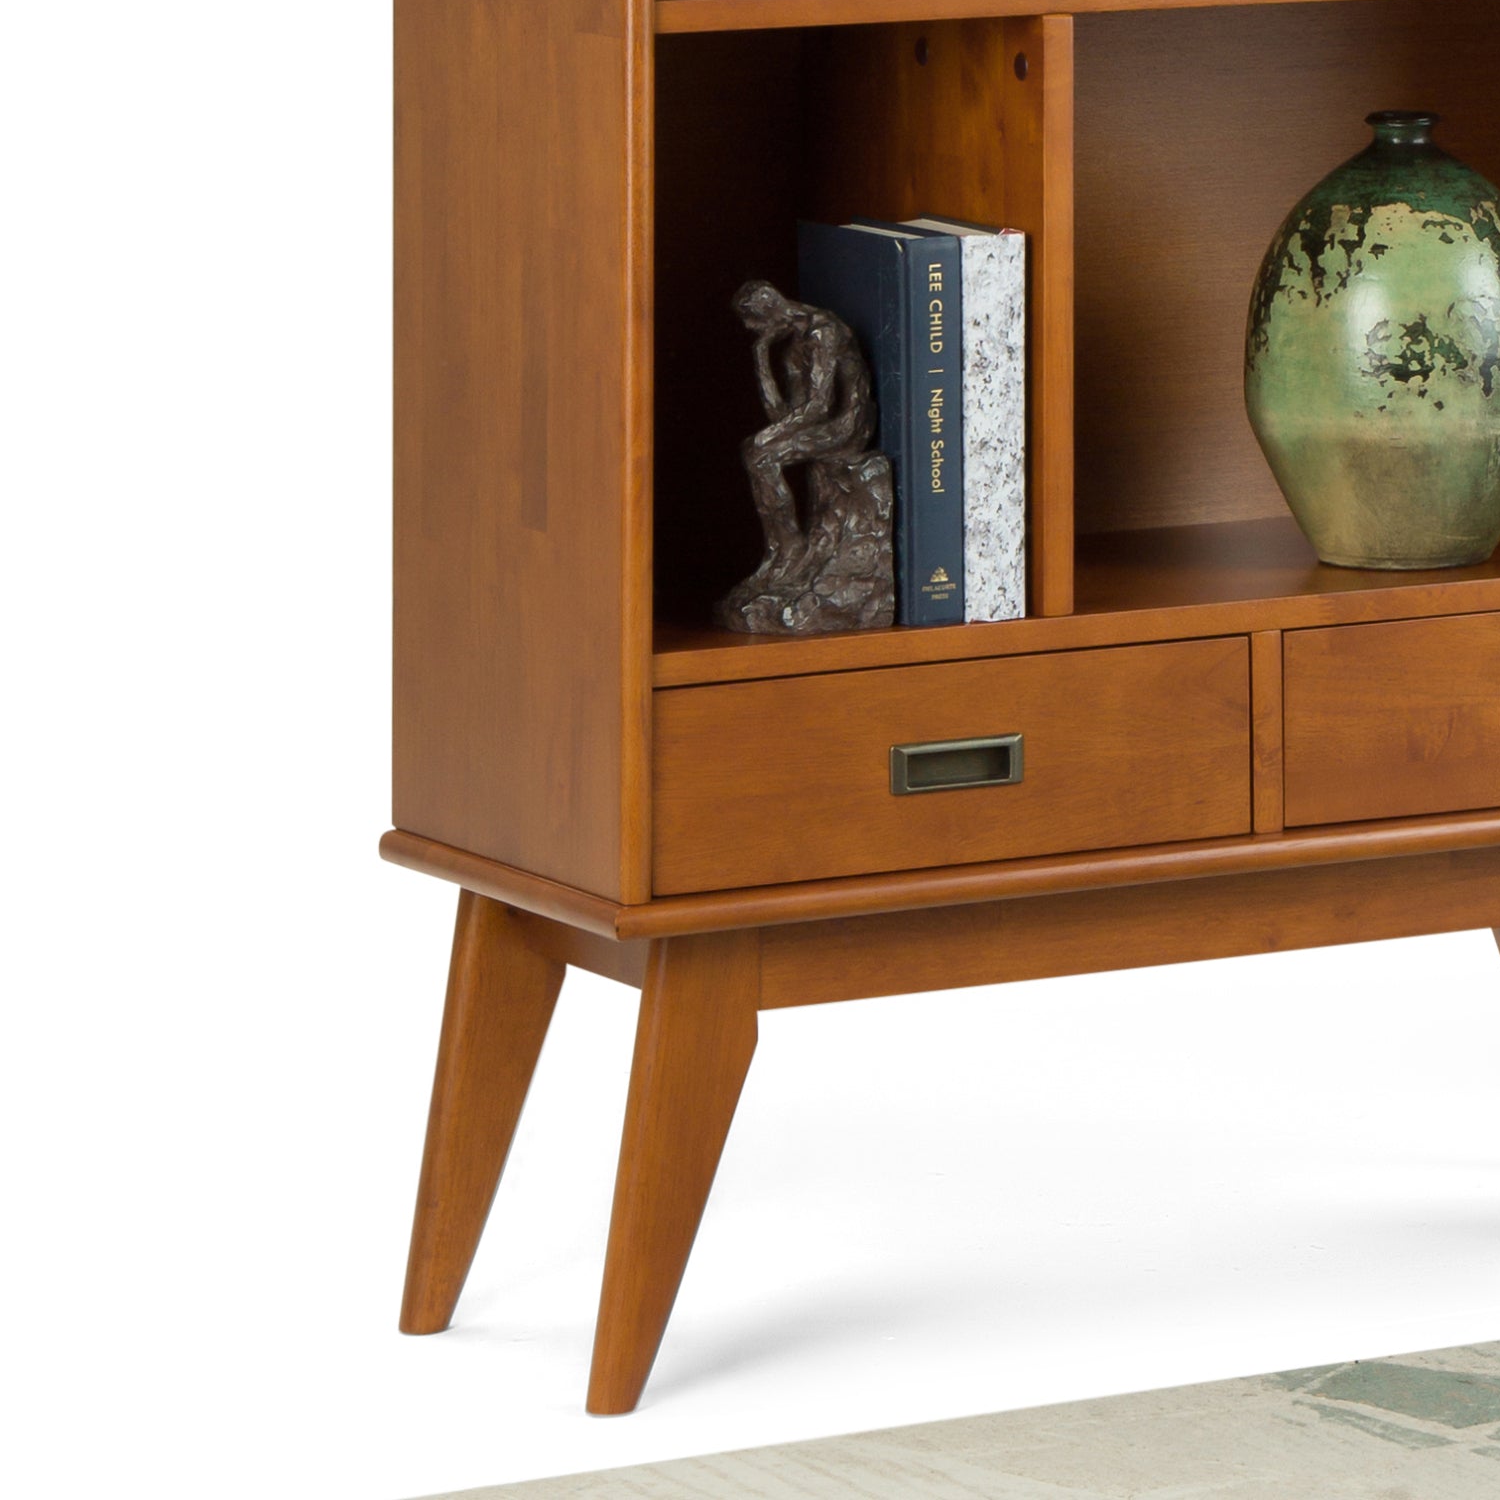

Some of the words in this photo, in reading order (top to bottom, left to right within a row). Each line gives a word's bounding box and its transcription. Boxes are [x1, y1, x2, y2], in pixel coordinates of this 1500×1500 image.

[928, 262, 943, 292] LEE
[928, 298, 944, 354] CHILD
[927, 388, 944, 434] Night
[929, 440, 945, 494] School
